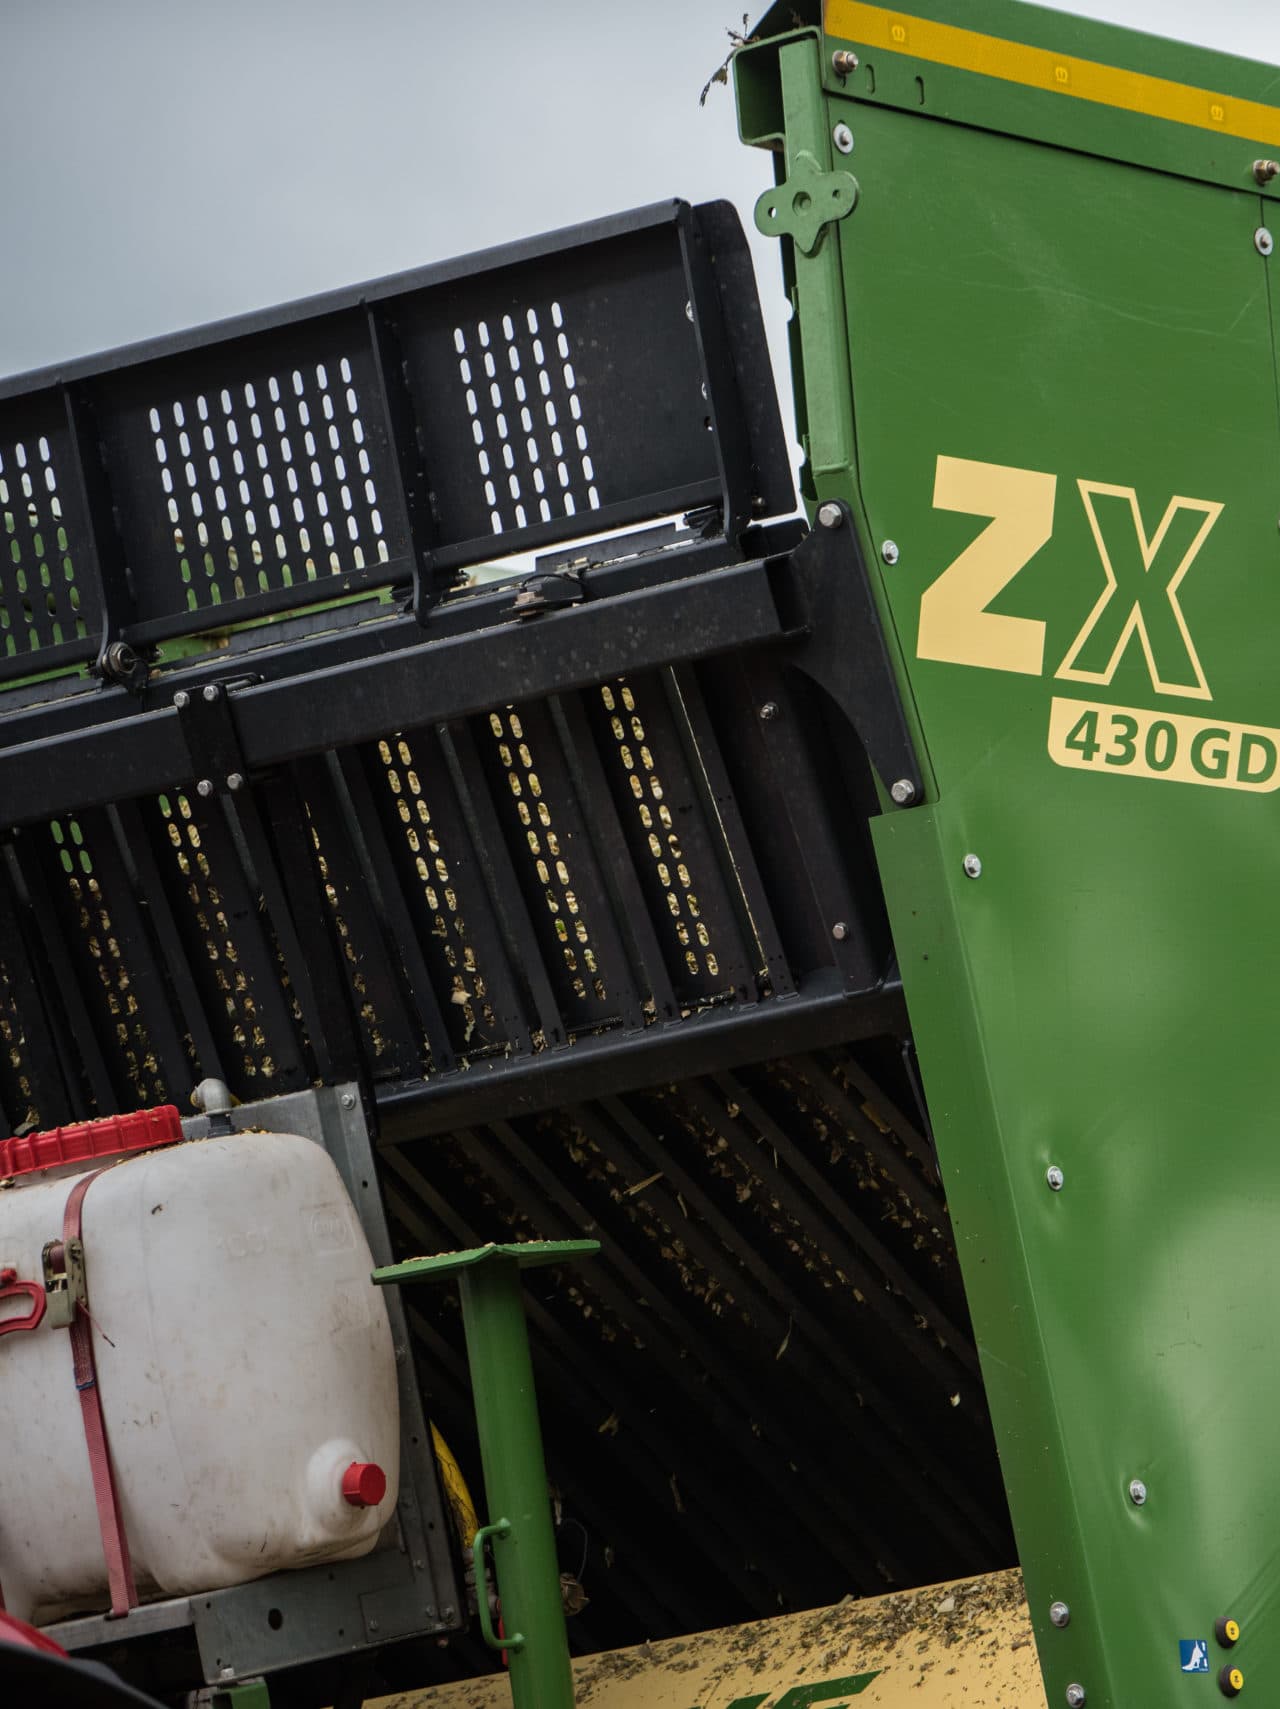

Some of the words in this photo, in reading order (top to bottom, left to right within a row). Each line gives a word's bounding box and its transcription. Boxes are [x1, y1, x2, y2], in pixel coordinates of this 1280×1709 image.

[916, 454, 1226, 701] ZX
[1064, 709, 1179, 772] 430
[1189, 727, 1278, 784] GD
